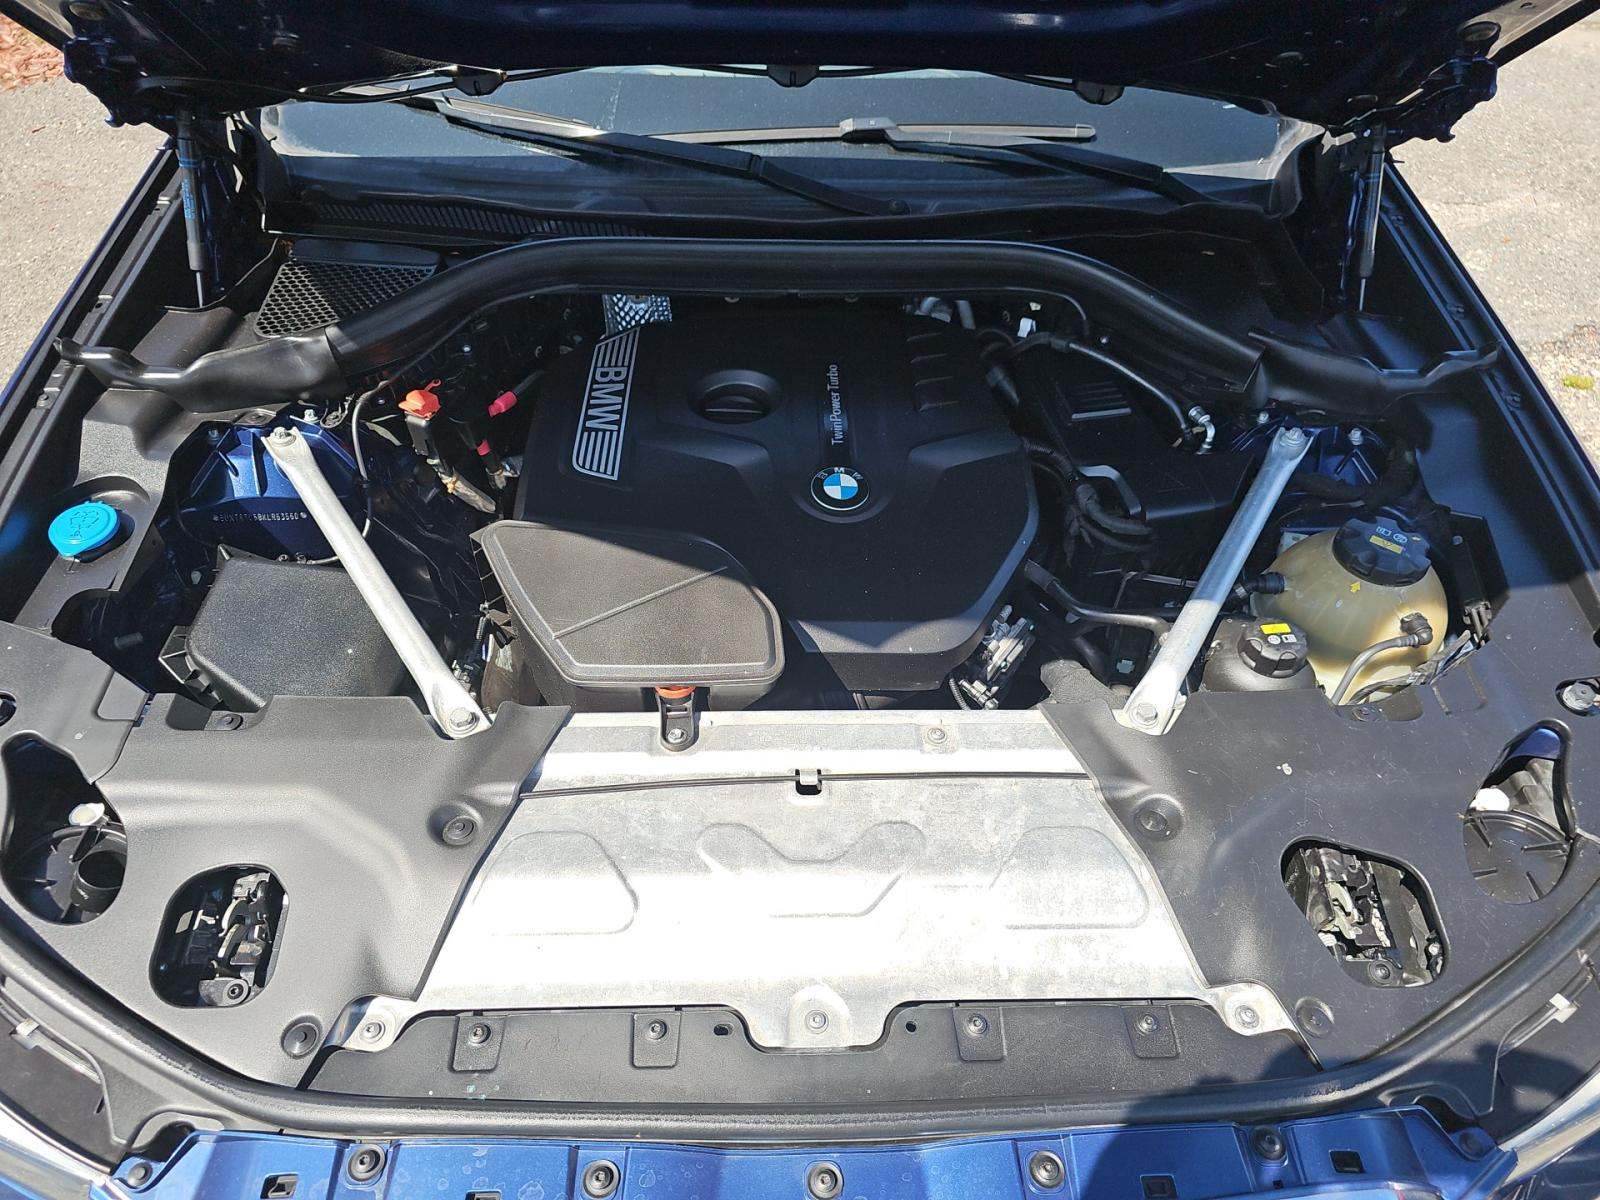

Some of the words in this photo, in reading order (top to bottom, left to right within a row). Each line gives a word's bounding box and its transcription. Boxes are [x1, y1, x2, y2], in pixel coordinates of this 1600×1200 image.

[585, 366, 628, 431] BMW
[826, 364, 840, 392] Turbo
[830, 391, 844, 446] TwinPower
